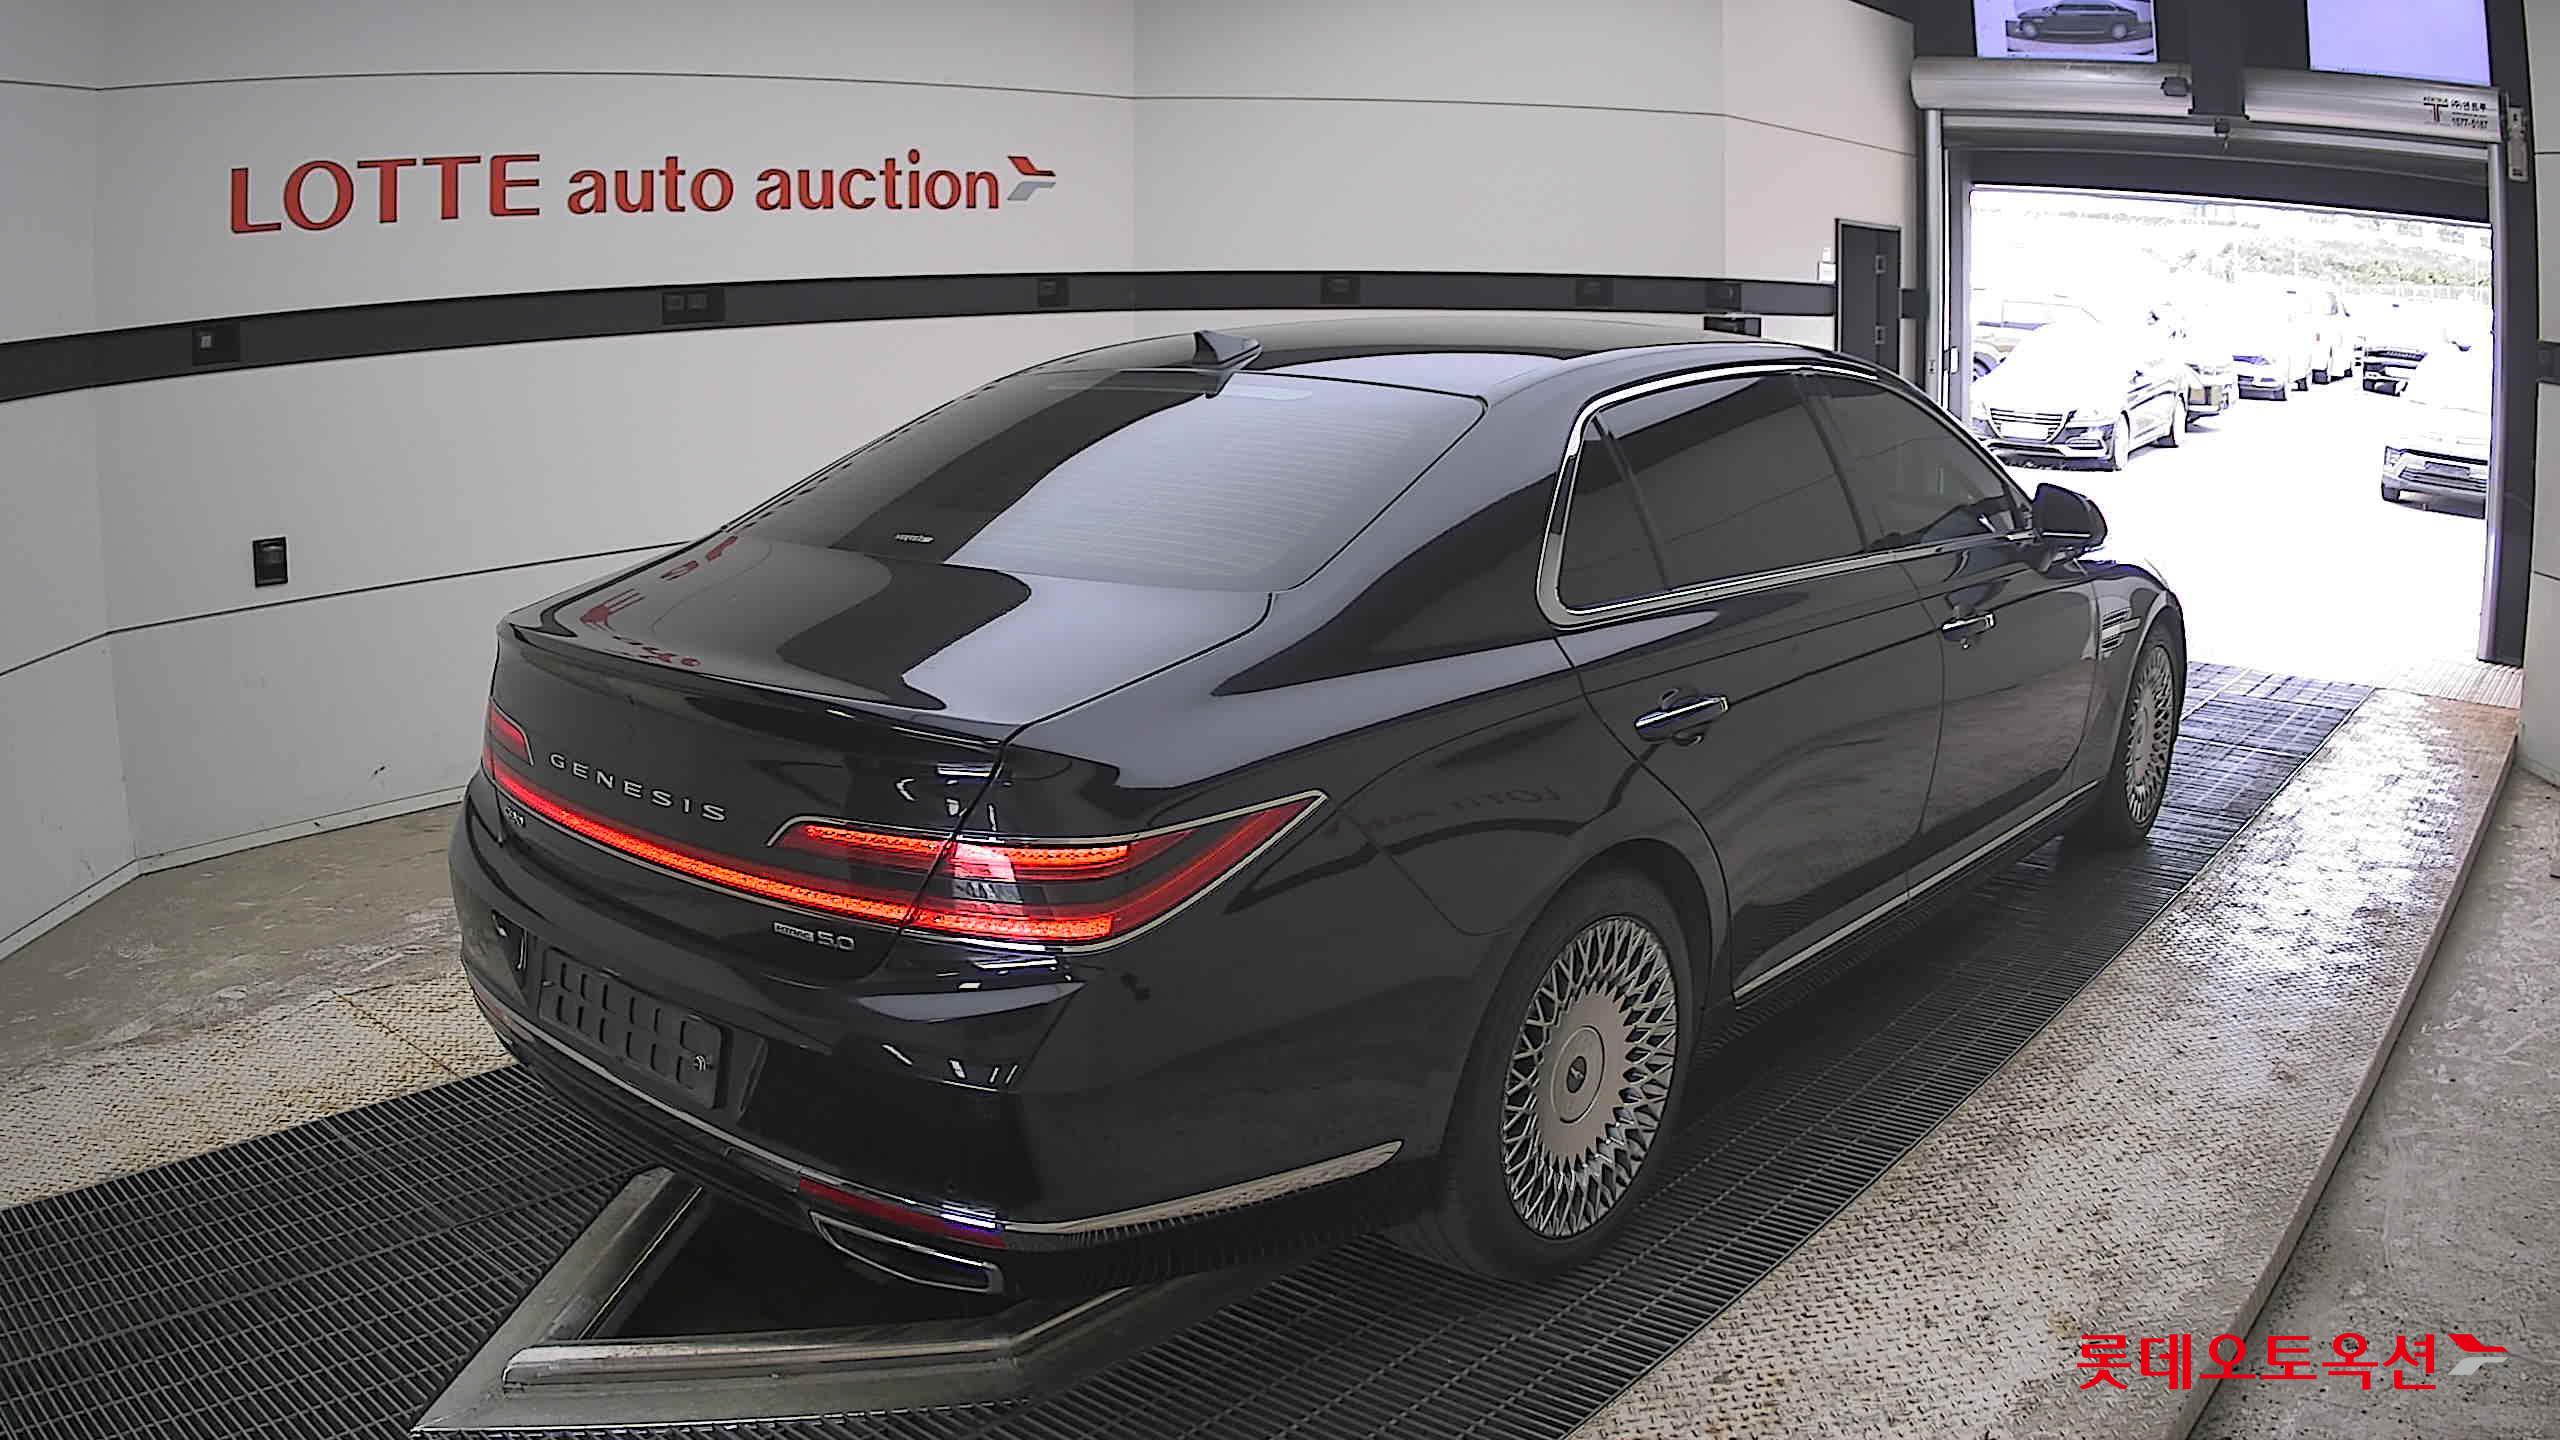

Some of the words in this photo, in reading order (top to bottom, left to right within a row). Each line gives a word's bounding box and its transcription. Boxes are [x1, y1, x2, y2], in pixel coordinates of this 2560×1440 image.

[231, 154, 541, 235] LOTTE
[567, 155, 735, 215] auto
[755, 148, 1000, 210] auction
[550, 753, 727, 822] GENESIS
